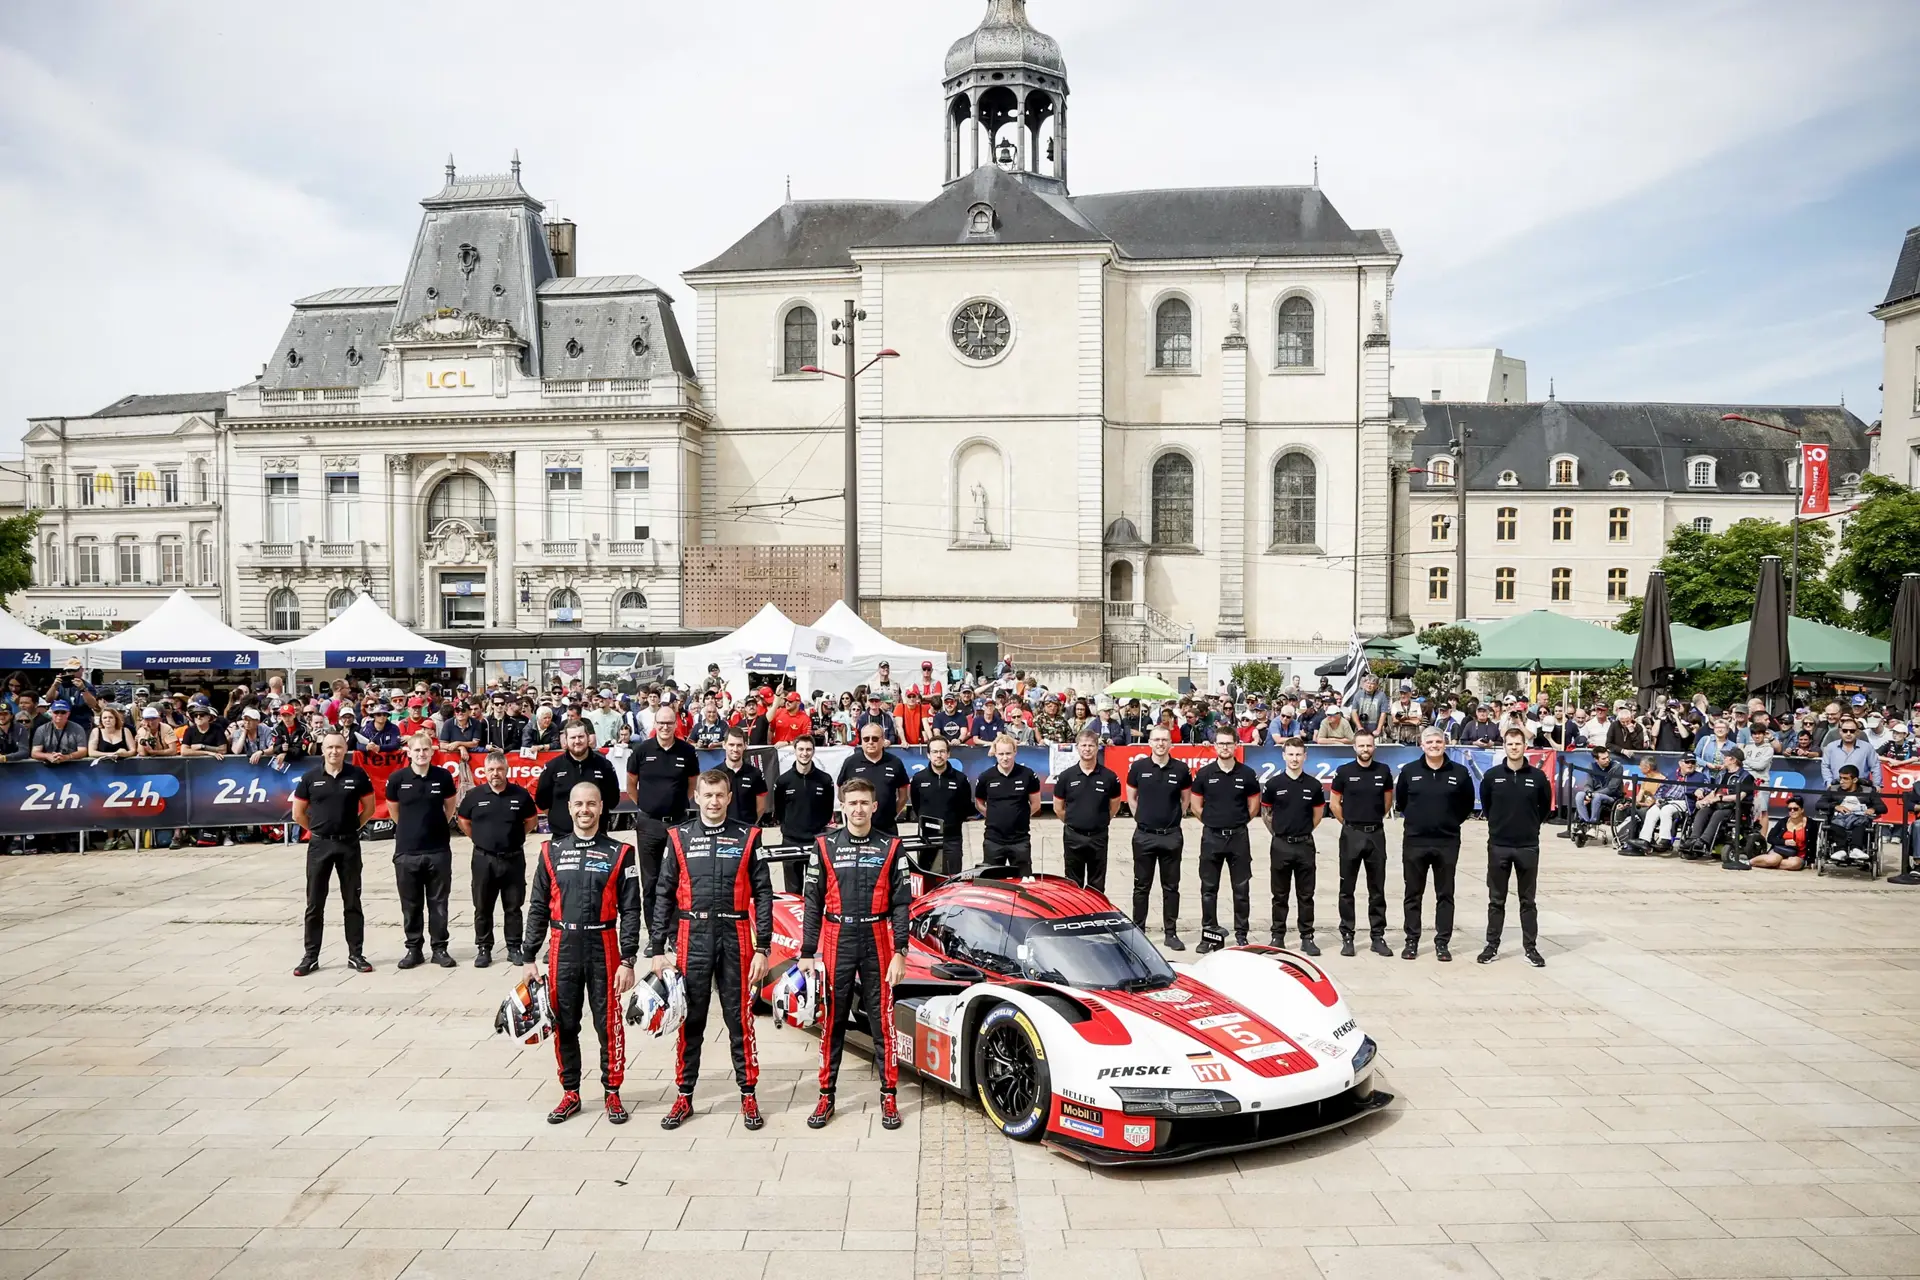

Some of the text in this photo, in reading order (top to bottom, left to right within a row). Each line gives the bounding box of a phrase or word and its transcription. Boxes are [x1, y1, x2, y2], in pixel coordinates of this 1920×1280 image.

[426, 369, 476, 389] LCL
[22, 652, 42, 662] 24h
[146, 656, 212, 664] RS AUTOMOBILES
[233, 653, 251, 662] 24h
[424, 653, 439, 661] 24h
[795, 652, 844, 665] PORSCHE
[20, 782, 83, 811] 24h
[103, 780, 163, 808] 24h
[213, 777, 269, 804] 24h
[911, 873, 923, 897] HY
[1053, 917, 1131, 932] PORSCHE
[771, 932, 800, 949] NSKE
[987, 1008, 1014, 1024] MICHELIN
[1220, 1024, 1262, 1044] 5
[1333, 1018, 1358, 1040] PENSKE
[926, 1031, 941, 1071] 5
[1097, 1065, 1173, 1080] PENSKE
[1194, 1064, 1225, 1081] HY
[1062, 1087, 1096, 1106] HELLER
[1063, 1103, 1090, 1120] Mobil
[1126, 1125, 1149, 1135] TAG
[1126, 1134, 1149, 1144] HEUER
